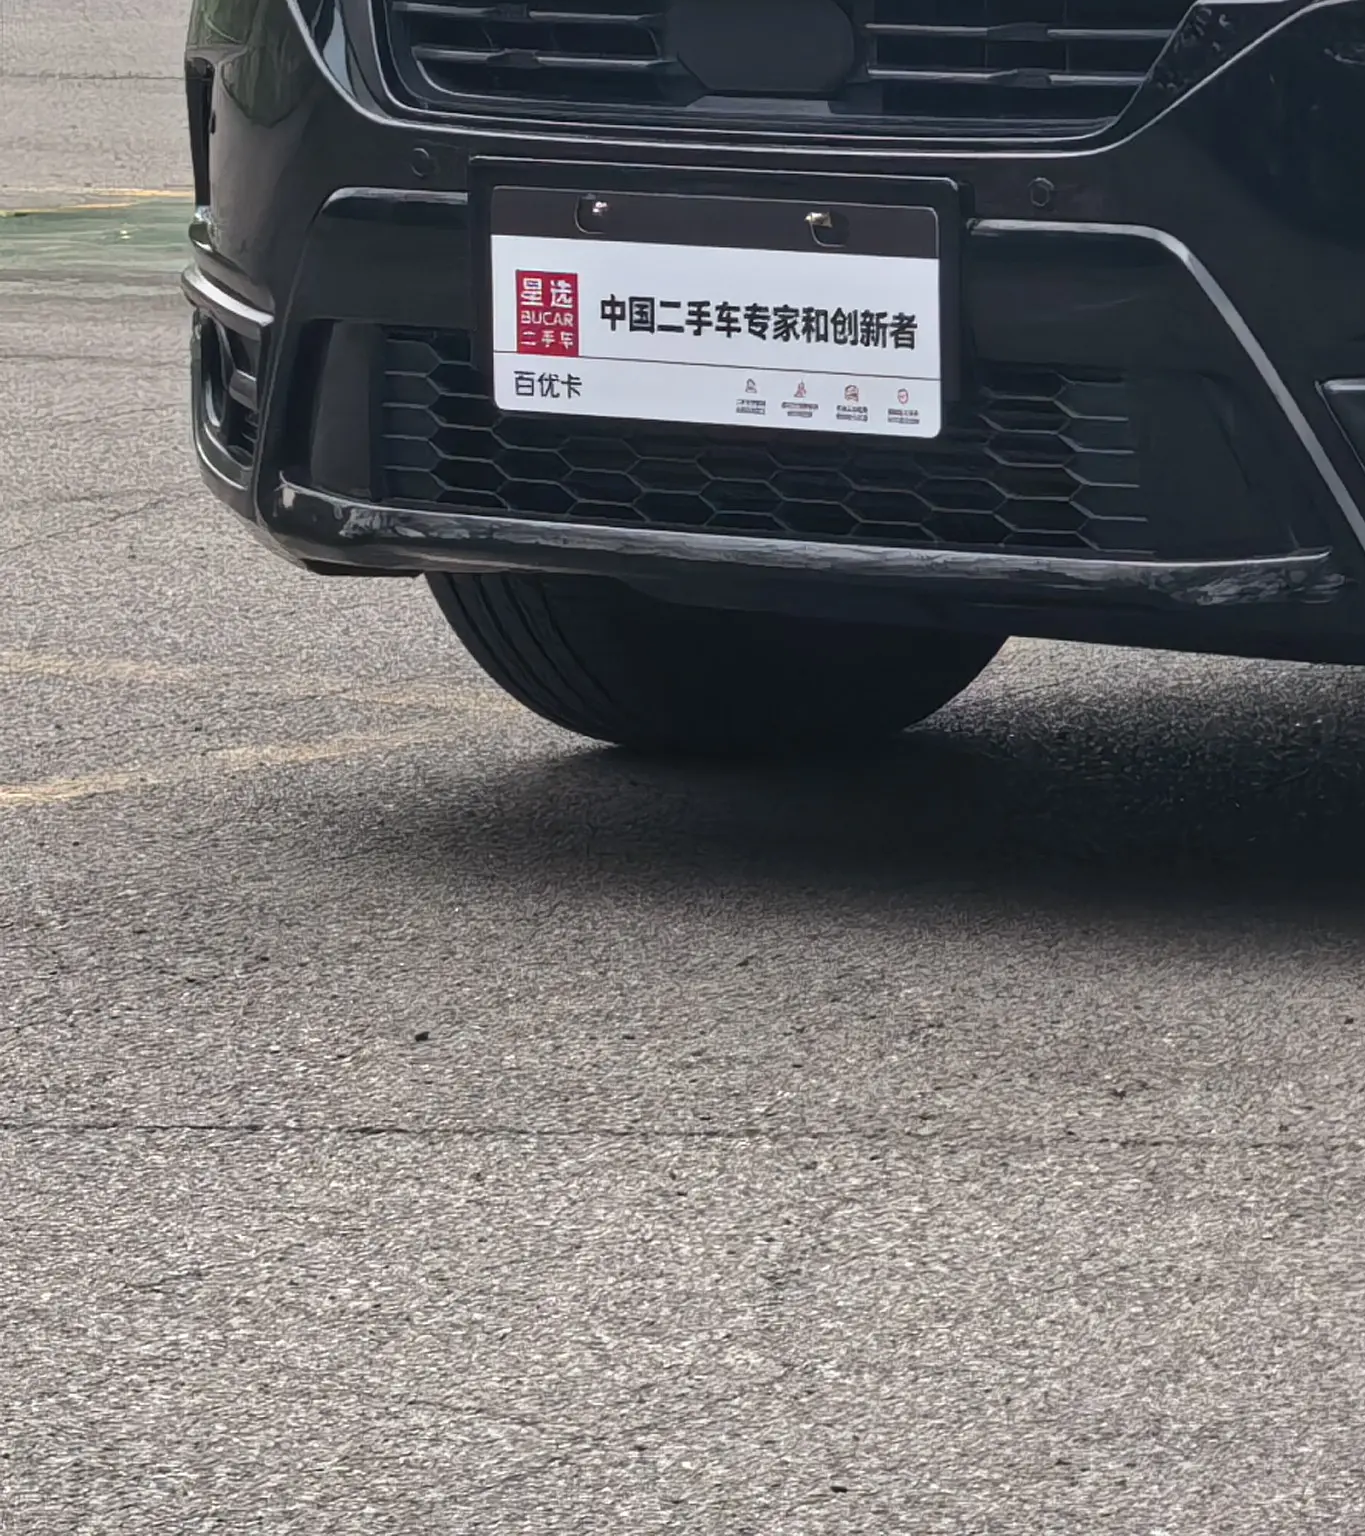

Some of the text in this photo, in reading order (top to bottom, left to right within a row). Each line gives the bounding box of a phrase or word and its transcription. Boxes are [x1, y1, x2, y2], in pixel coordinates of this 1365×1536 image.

[520, 277, 574, 309] 星选
[520, 310, 574, 327] BUCAR
[600, 294, 918, 350] 中国二手车专家和创新者
[520, 329, 574, 350] 二手车
[513, 369, 583, 399] 百优卡
